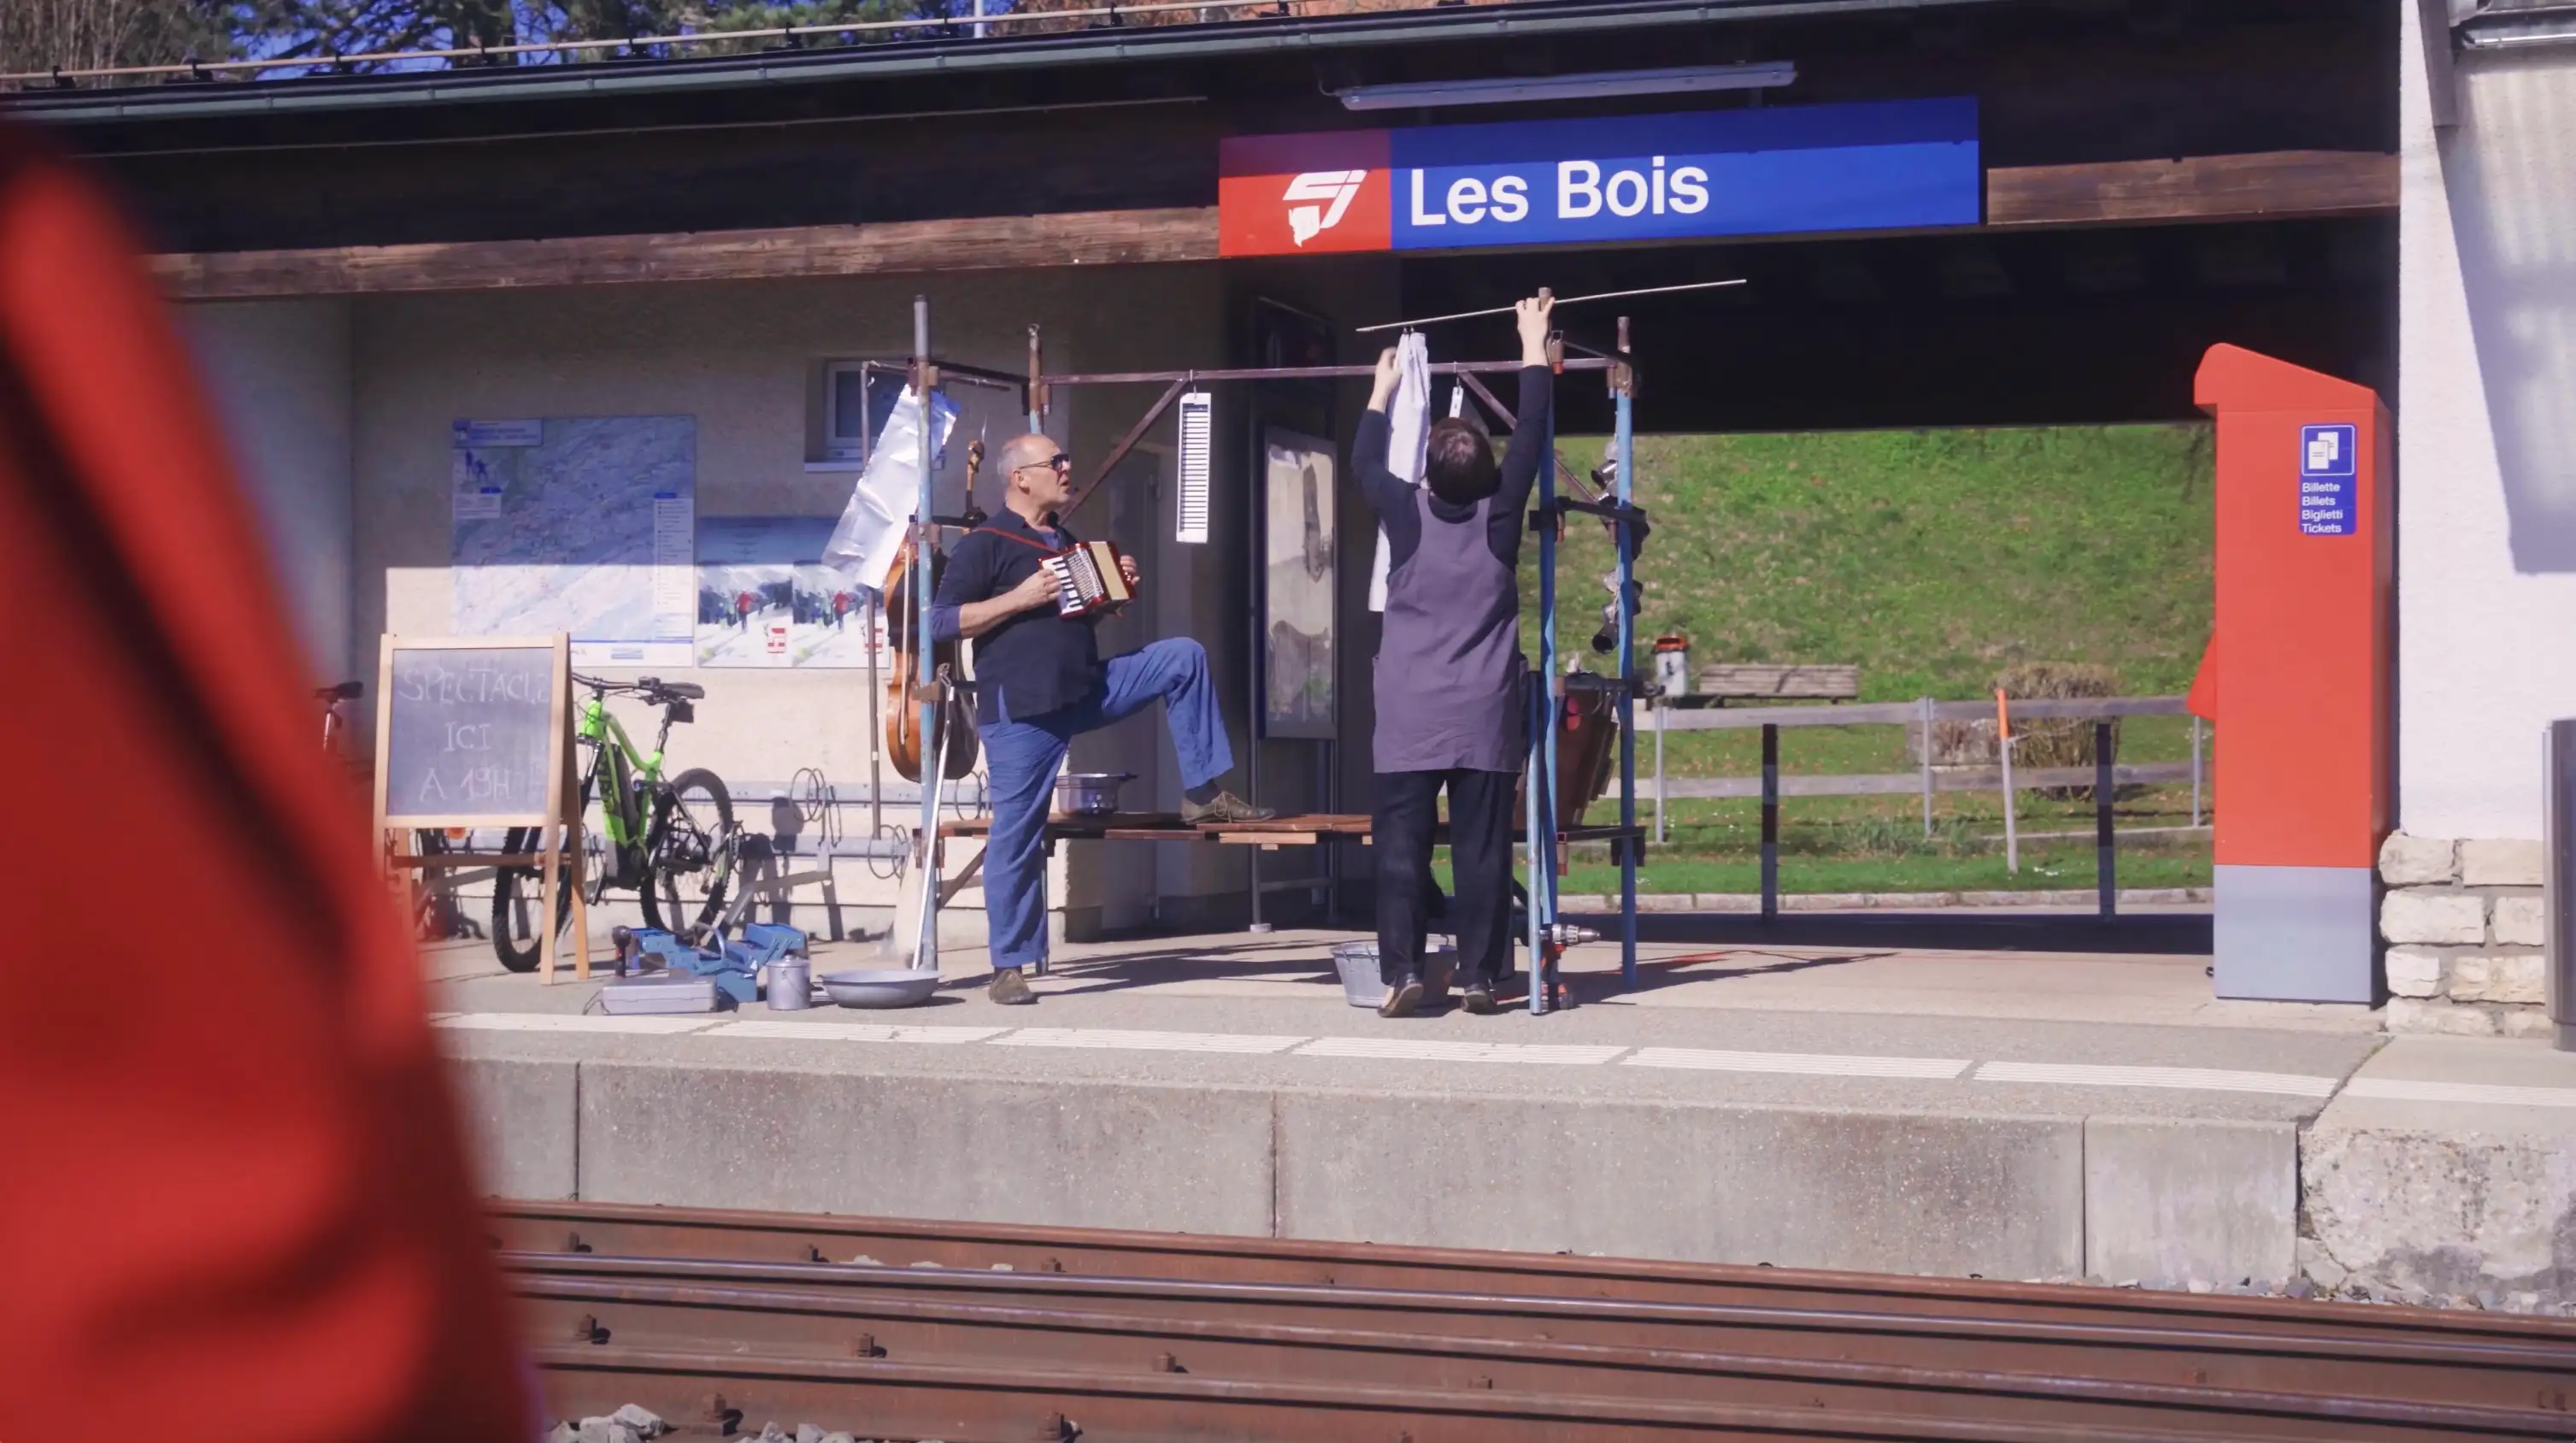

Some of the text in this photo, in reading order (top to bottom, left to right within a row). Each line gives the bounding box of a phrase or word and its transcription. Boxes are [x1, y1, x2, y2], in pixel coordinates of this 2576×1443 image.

[1411, 156, 1709, 226] Les Bois
[2301, 482, 2341, 493] Billette
[2301, 496, 2336, 507] Billets
[2301, 509, 2344, 522] Biglietti
[2301, 523, 2342, 533] Tickets
[443, 722, 492, 752] ICI
[419, 767, 449, 802] A
